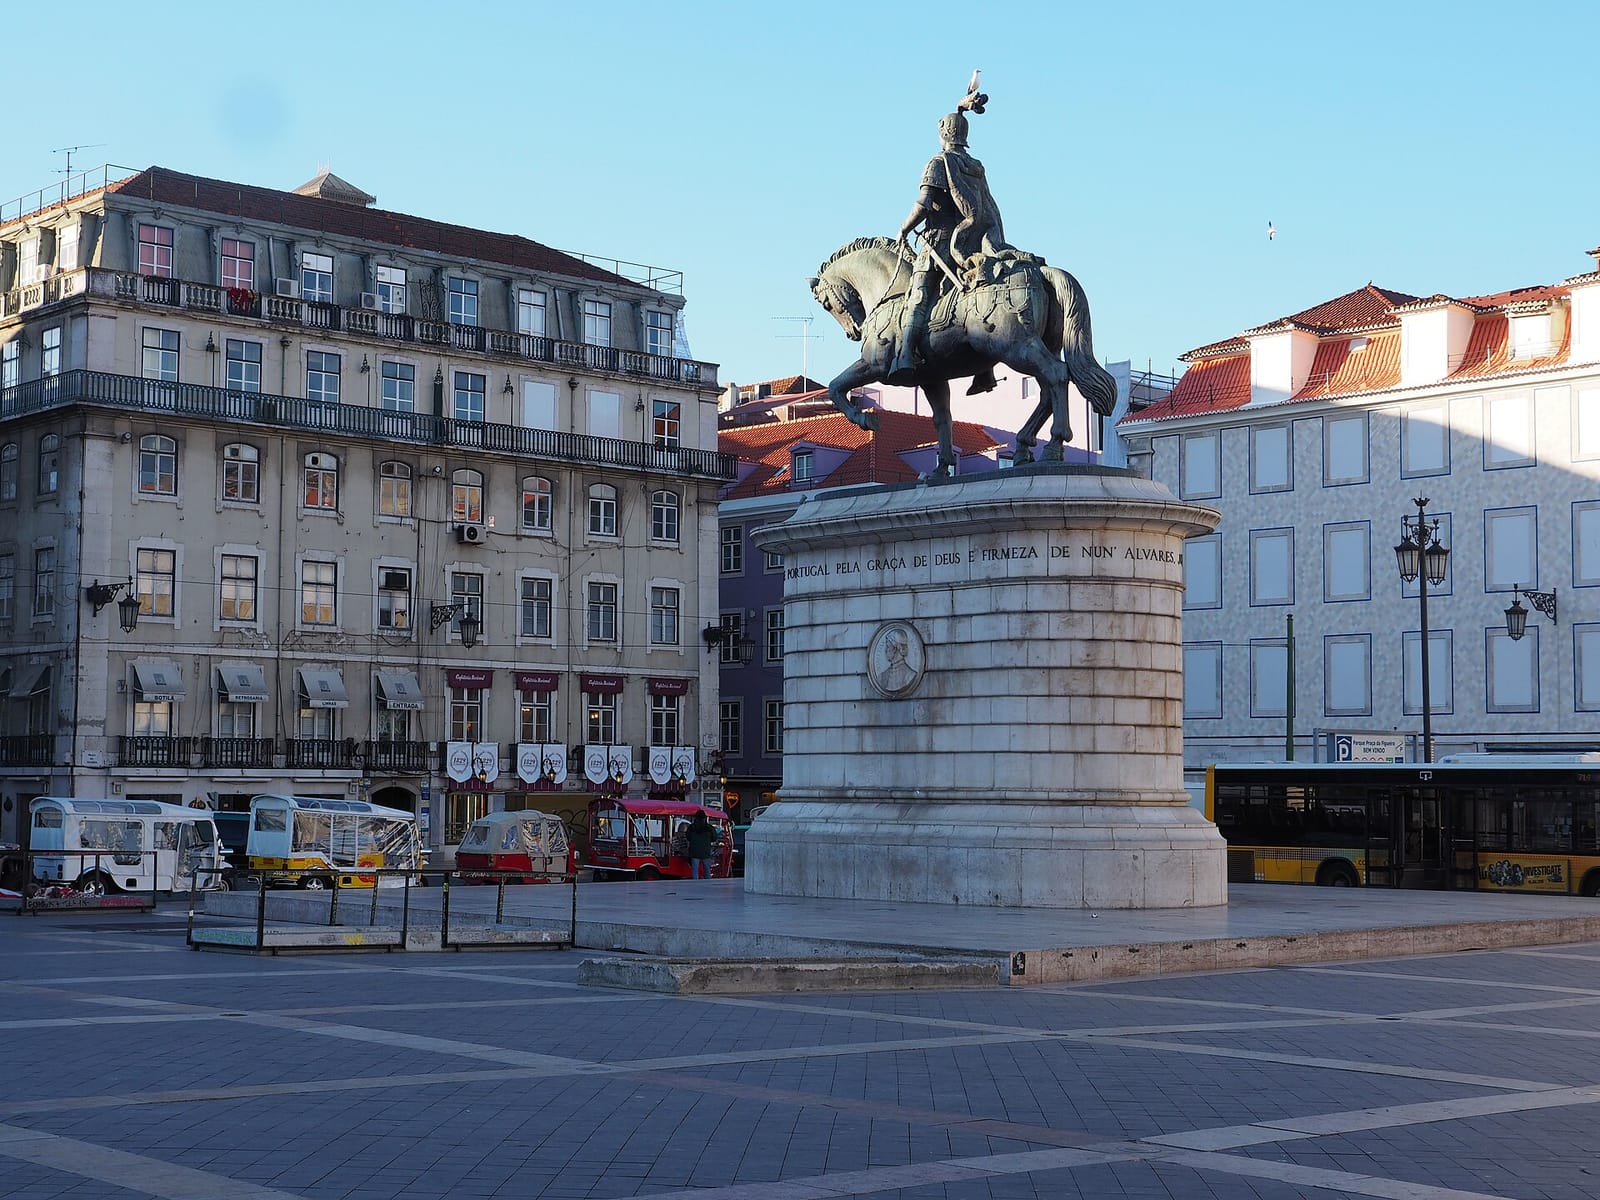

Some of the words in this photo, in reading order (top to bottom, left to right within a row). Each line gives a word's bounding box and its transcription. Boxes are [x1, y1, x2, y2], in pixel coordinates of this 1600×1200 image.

[787, 564, 830, 580] PORTUGAL
[836, 561, 861, 575] PELA
[913, 555, 928, 568] DE
[935, 552, 961, 566] DEUS
[968, 550, 976, 563] E
[982, 546, 1039, 561] FIRMEZA
[1050, 545, 1071, 558] DE
[1523, 864, 1562, 876] INVESTIGATE
